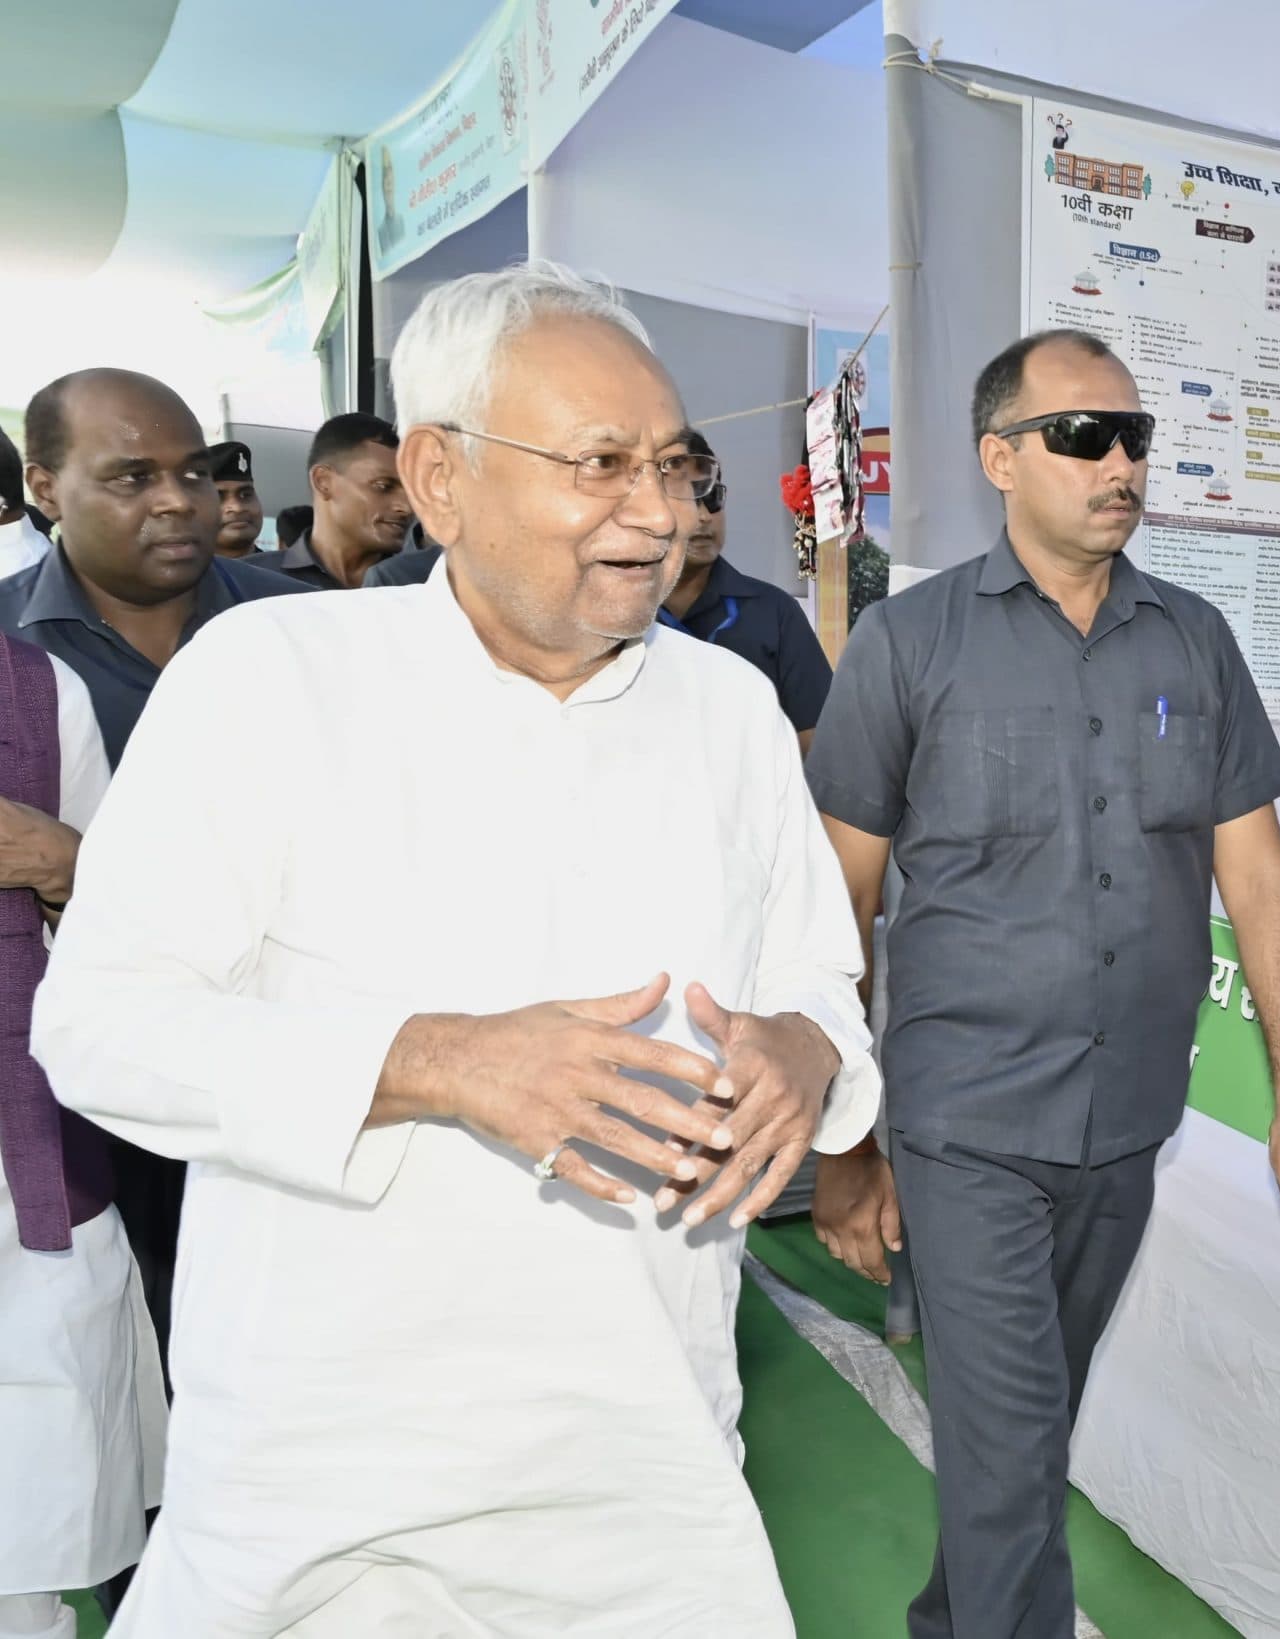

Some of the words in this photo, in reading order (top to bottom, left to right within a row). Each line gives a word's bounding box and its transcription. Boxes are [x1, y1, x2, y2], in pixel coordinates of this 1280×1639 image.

[1182, 161, 1213, 182] उच्च
[1216, 166, 1268, 196] शिक्षा,
[1097, 202, 1133, 221] कक्षा
[1072, 212, 1088, 224] (10th
[1090, 217, 1122, 232] standard)
[1113, 242, 1137, 258] विज्ञान
